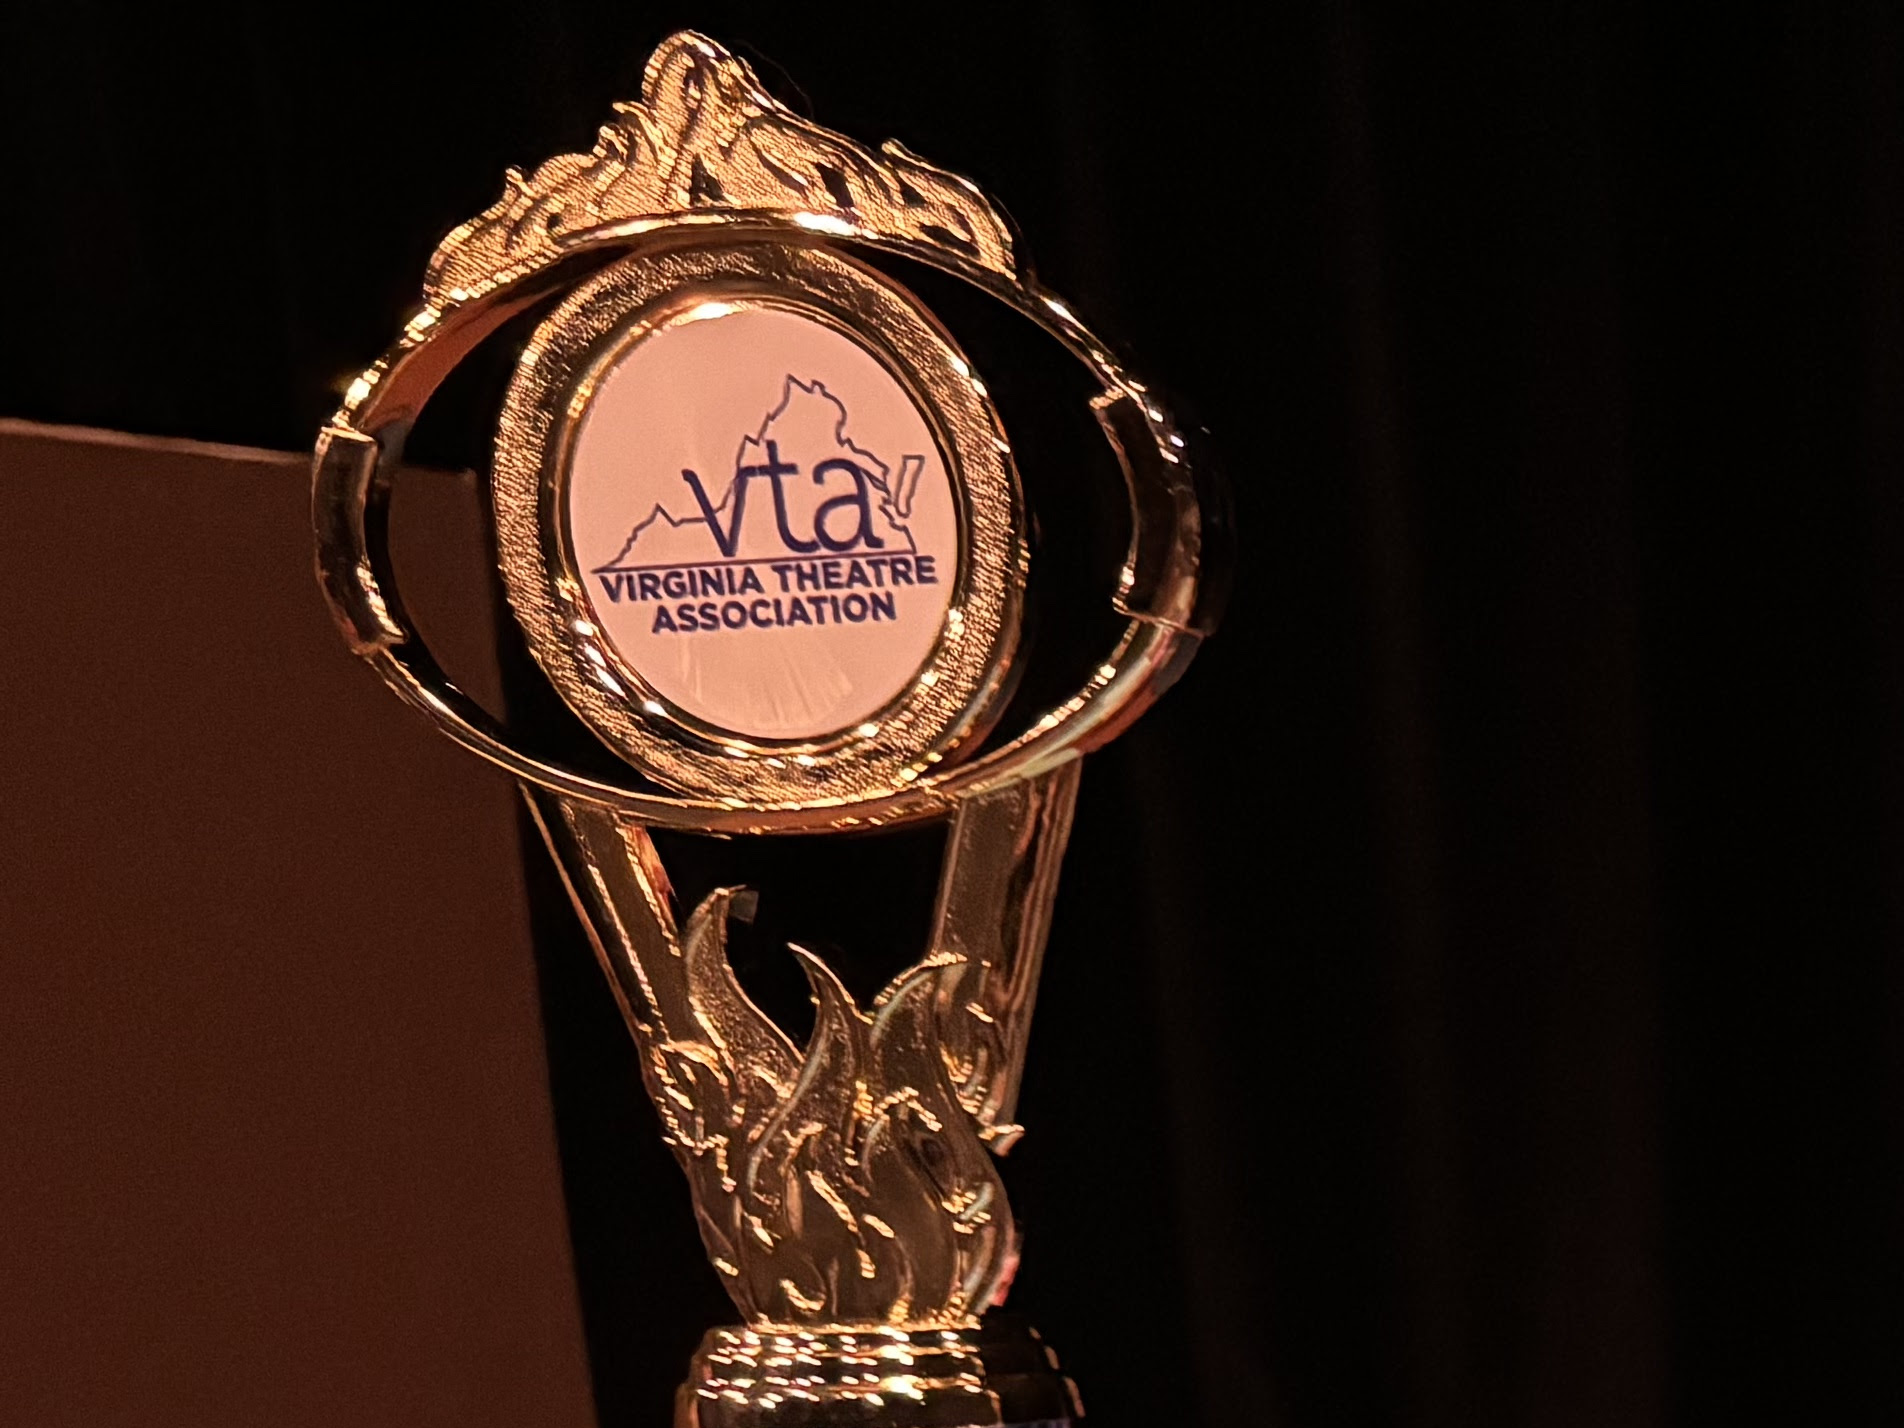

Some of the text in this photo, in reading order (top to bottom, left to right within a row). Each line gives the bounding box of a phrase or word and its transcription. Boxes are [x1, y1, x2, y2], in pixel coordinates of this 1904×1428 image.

[682, 438, 886, 558] vta
[599, 555, 939, 604] VIRGINIA THEATRE
[652, 592, 897, 635] ASSOCIATION
